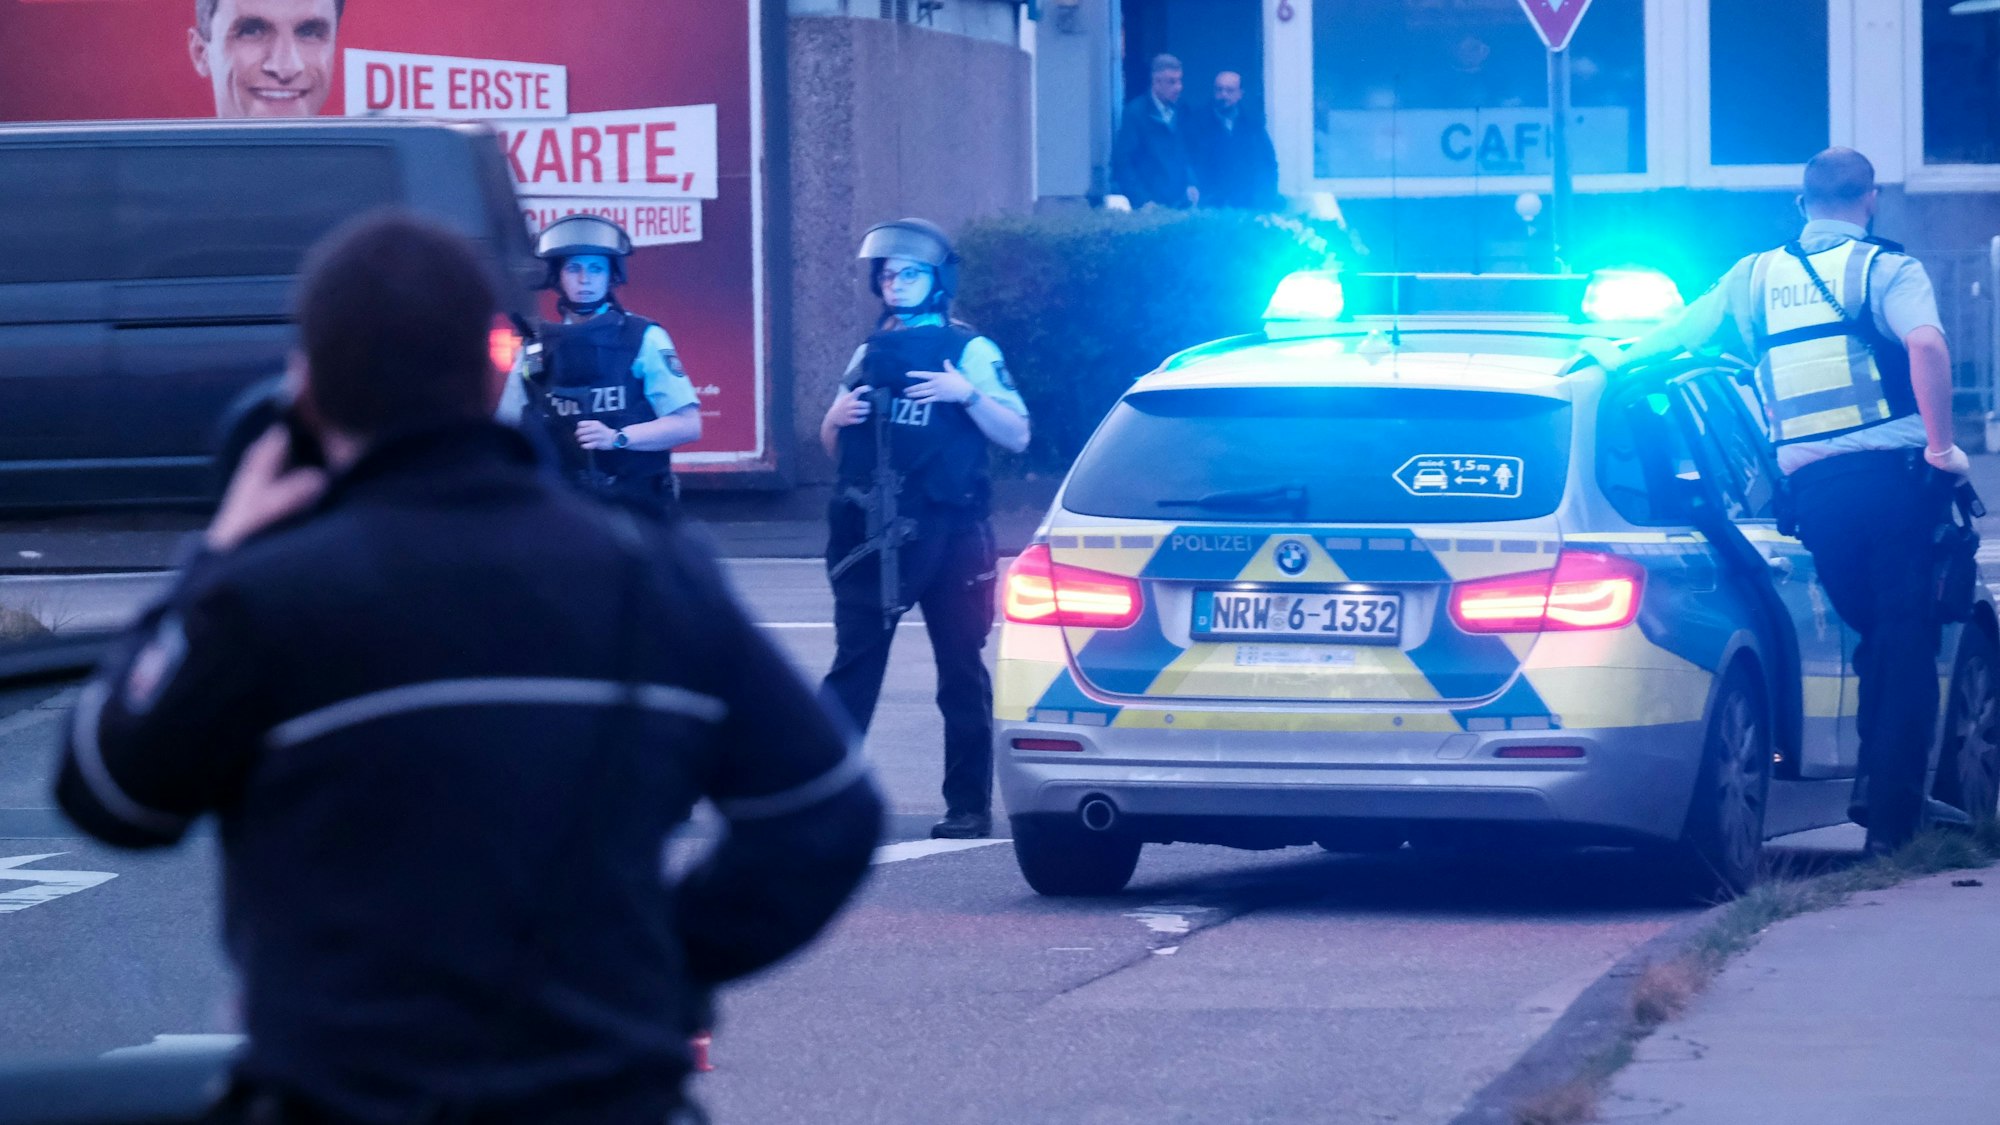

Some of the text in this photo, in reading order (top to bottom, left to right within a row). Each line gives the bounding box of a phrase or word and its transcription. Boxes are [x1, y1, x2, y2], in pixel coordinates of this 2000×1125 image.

[365, 62, 550, 110] DIE ERSTE
[499, 121, 695, 191] KARTE,
[1441, 123, 1551, 161] CAF
[635, 206, 696, 237] FREUE.
[1771, 279, 1837, 310] POLIZI
[1171, 535, 1252, 551] POLIZEI
[1213, 596, 1271, 630] NRW
[1288, 598, 1396, 634] 6-1332
